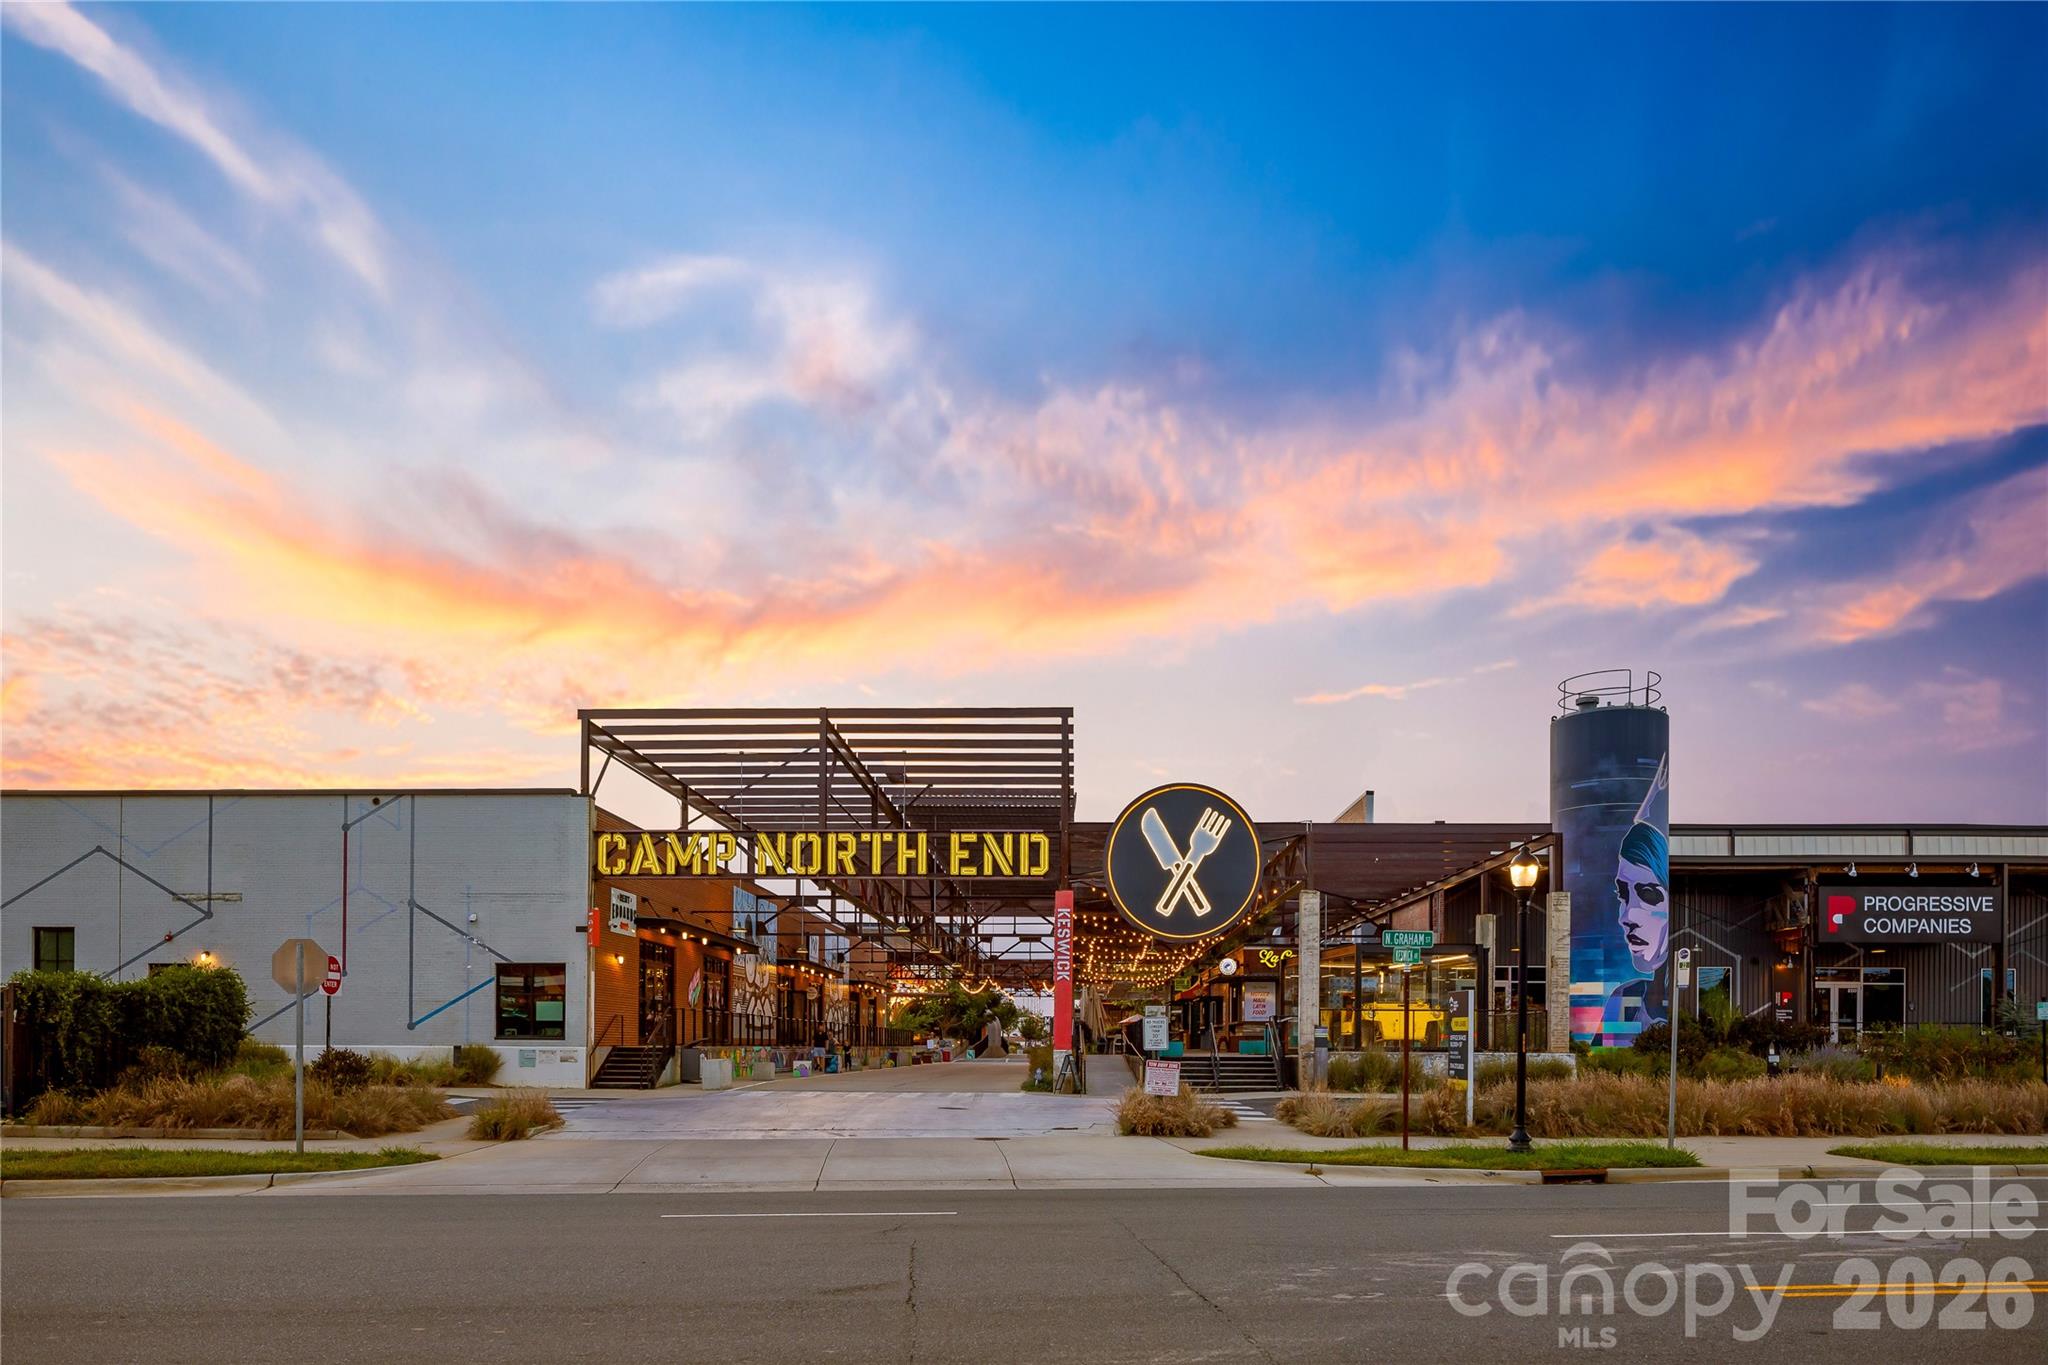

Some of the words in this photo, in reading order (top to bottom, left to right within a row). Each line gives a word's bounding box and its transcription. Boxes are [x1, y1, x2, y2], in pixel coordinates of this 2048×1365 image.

[597, 832, 737, 875] CAMP
[756, 832, 928, 876] NORTH
[950, 832, 1050, 876] END
[1864, 896, 1994, 912] PROGRESSIVE
[1864, 918, 1972, 934] COMPANIES
[1057, 908, 1071, 981] KESWICK
[1385, 932, 1393, 945] N.
[1394, 932, 1425, 946] GRAHAM
[1259, 949, 1279, 968] La
